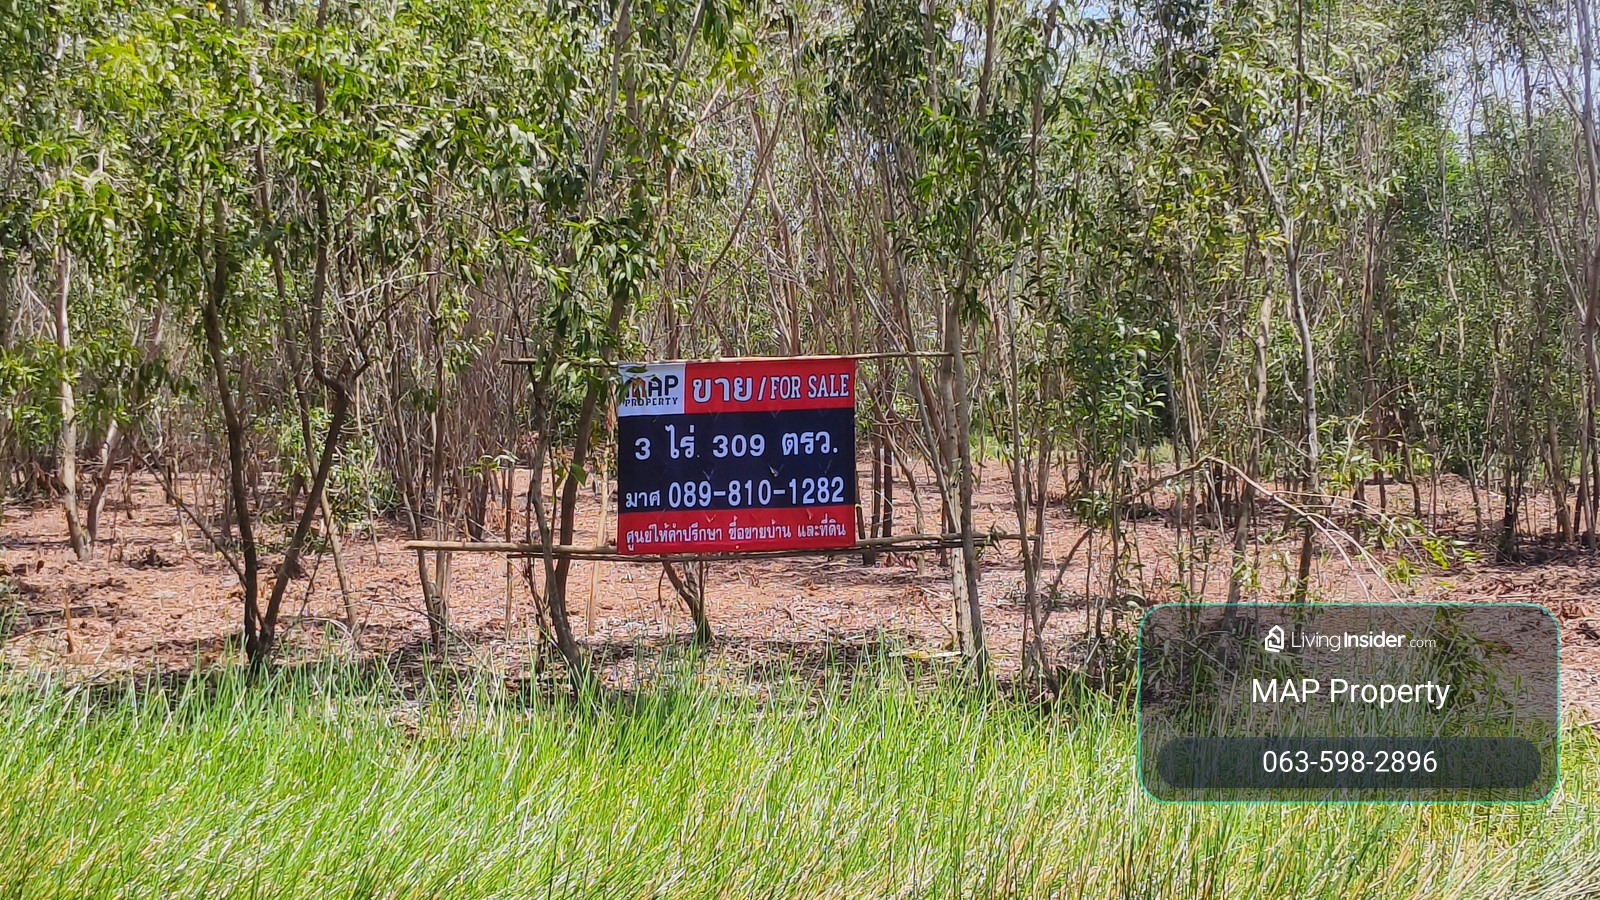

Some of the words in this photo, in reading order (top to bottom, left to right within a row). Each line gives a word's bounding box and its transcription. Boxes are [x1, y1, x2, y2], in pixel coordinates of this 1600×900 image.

[625, 397, 678, 407] PROPERTY
[692, 377, 753, 403] ขาย
[808, 374, 849, 399] SALE
[634, 437, 651, 460] 3
[712, 434, 765, 458] 309
[781, 431, 838, 456] ตรว.
[625, 490, 660, 508] มาศ
[668, 476, 844, 508] 089-810-1282
[797, 513, 846, 538] และที่ดิน
